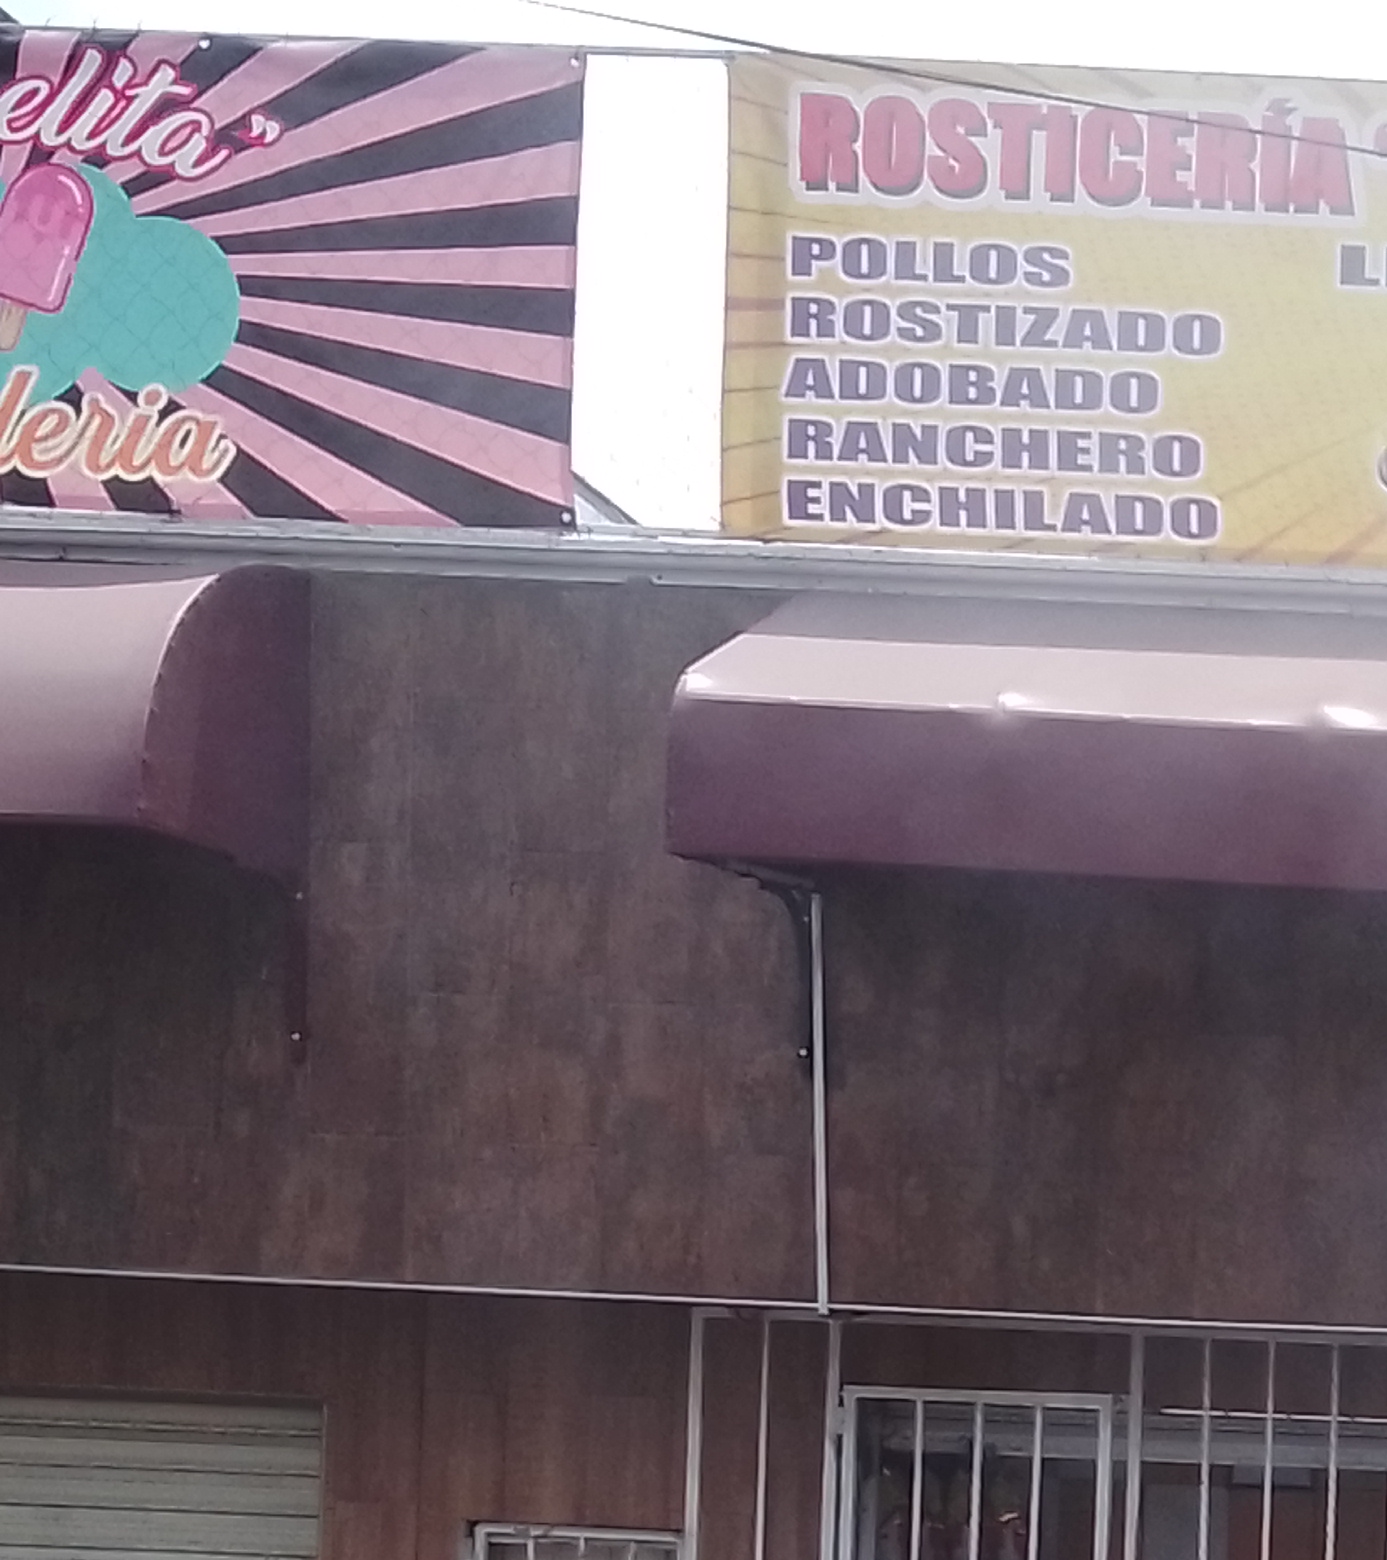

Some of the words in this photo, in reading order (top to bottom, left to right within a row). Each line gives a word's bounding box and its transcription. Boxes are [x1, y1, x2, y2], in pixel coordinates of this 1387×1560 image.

[799, 93, 1356, 217] ROSTICERÍA
[790, 235, 1071, 288] POLLOS
[789, 296, 1223, 356] ROSTIZADO
[784, 358, 1160, 414] ADOBADO
[787, 419, 1202, 478] RANCHERO
[786, 480, 1219, 541] ENCHILADO
